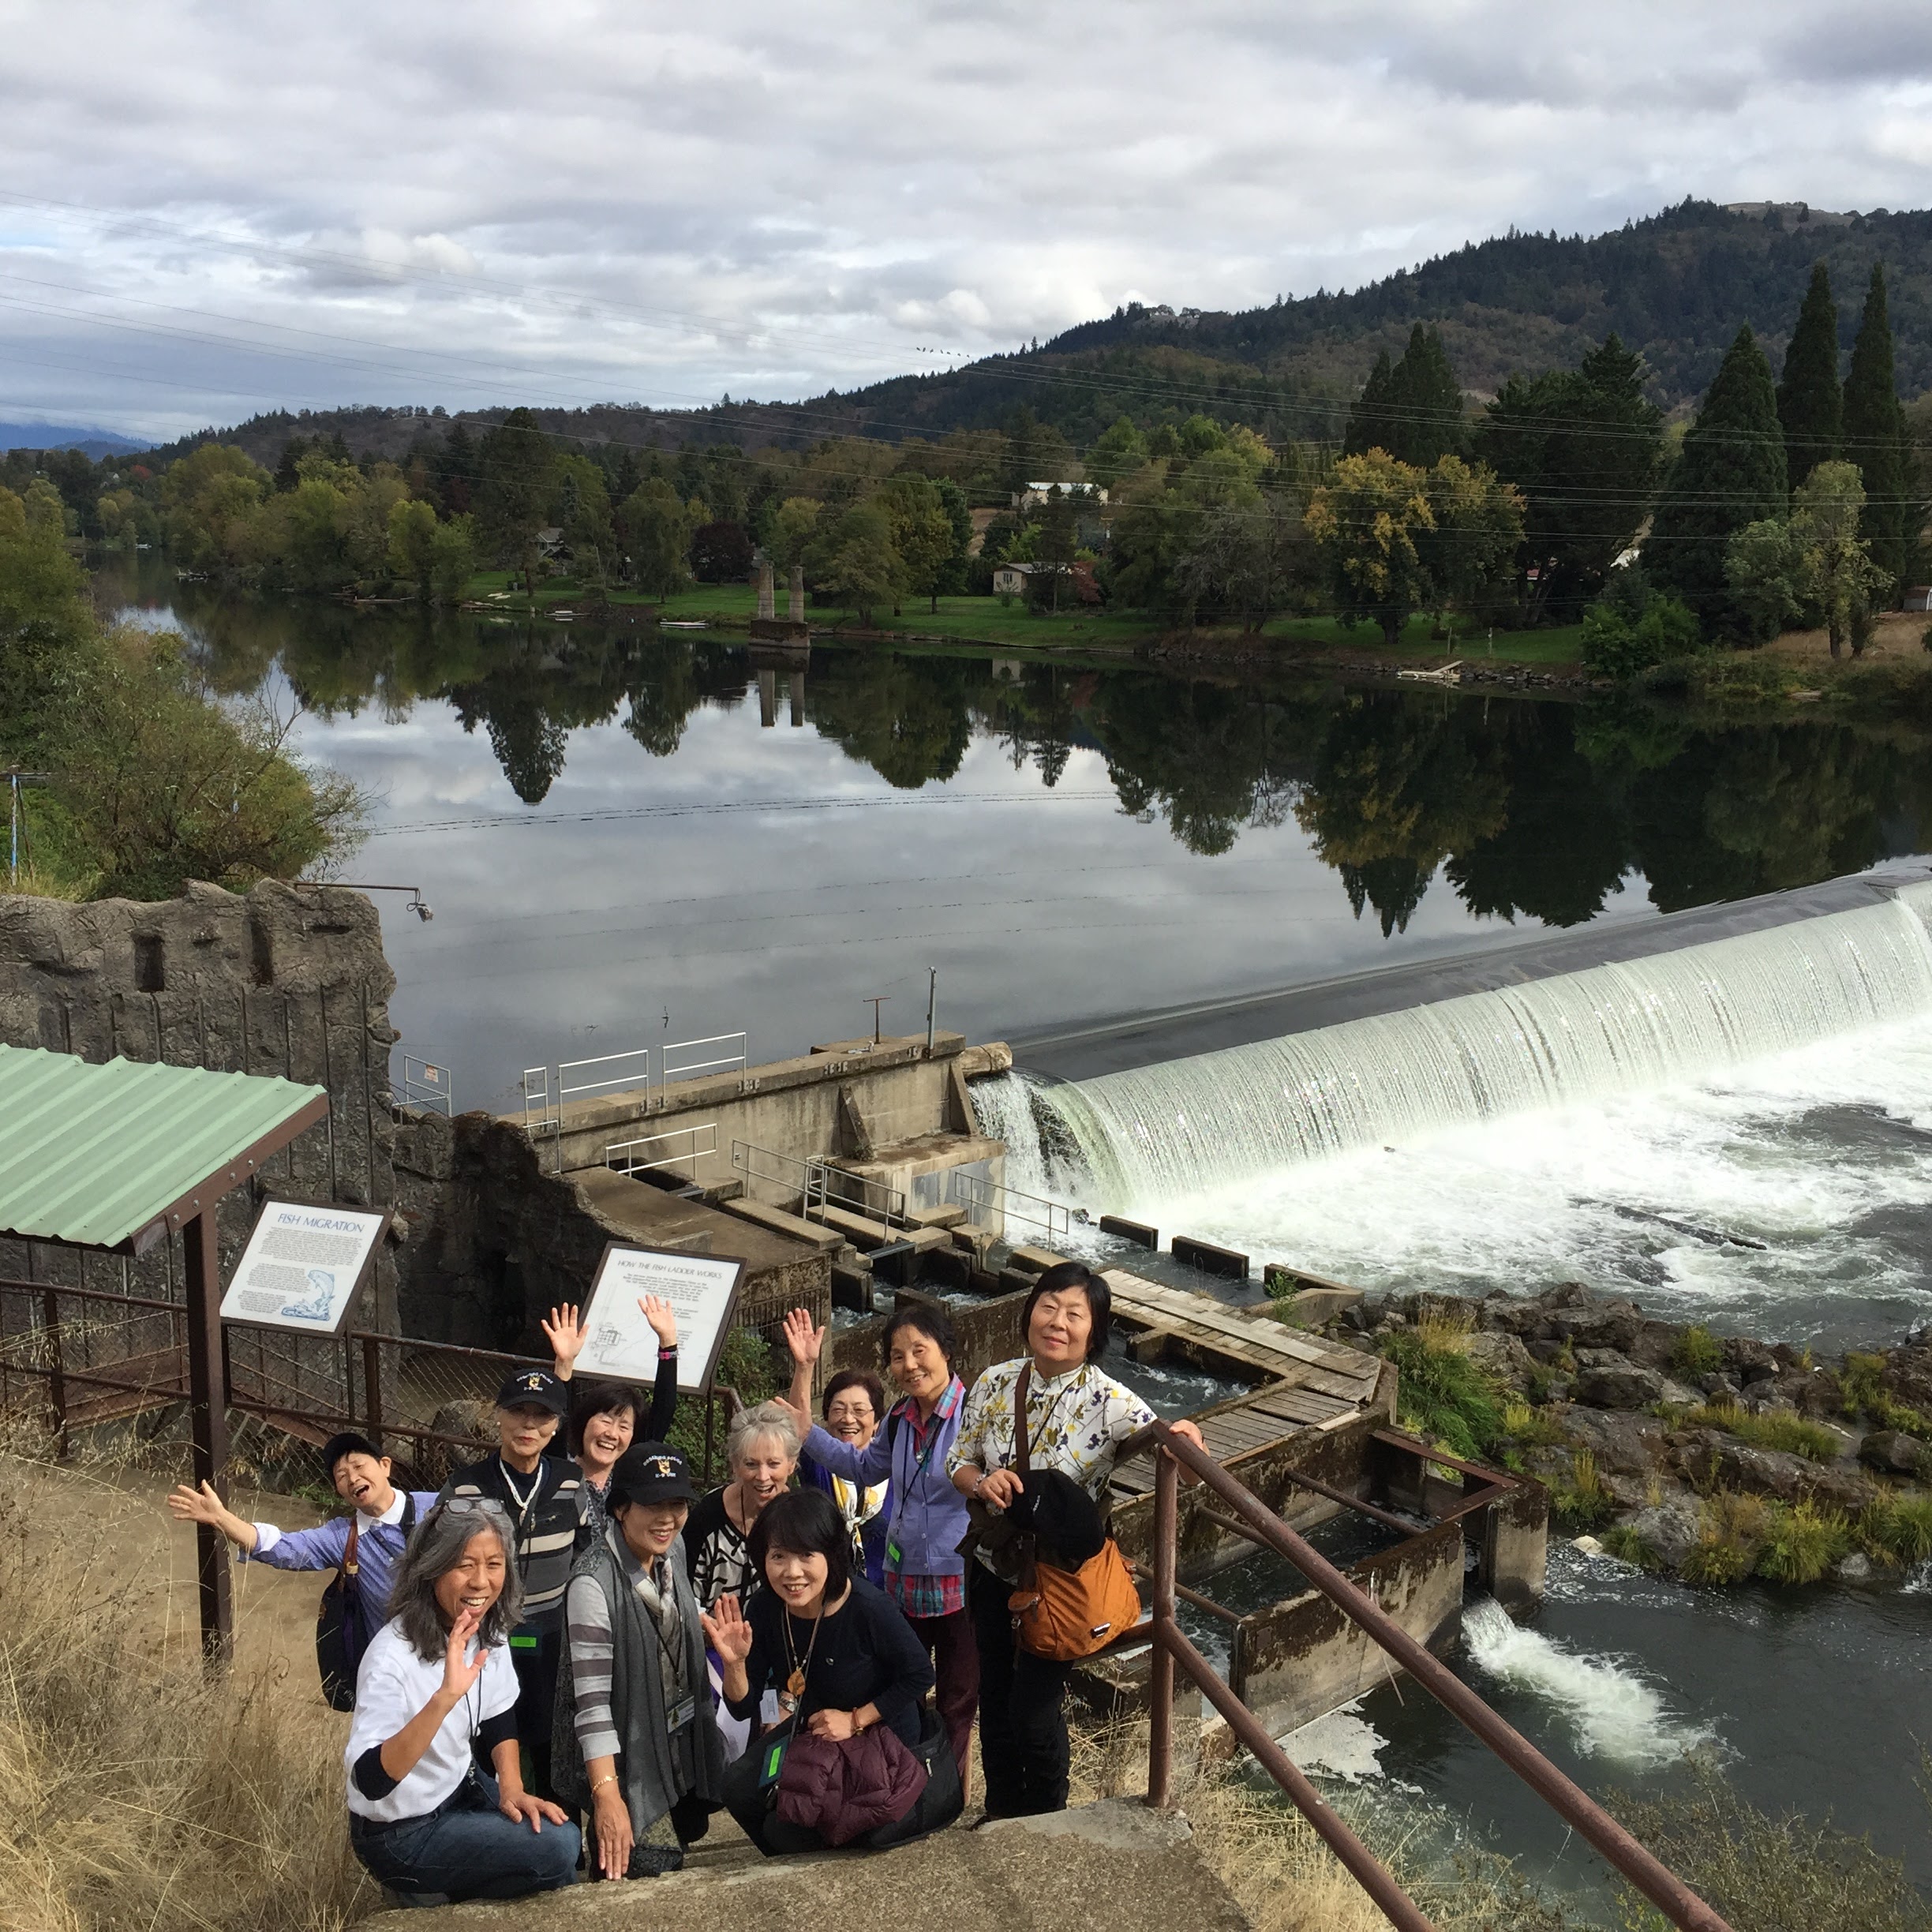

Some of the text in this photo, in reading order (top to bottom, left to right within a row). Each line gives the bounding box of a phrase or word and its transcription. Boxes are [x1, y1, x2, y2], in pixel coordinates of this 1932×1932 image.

[278, 1213, 365, 1233] FISH MIGRATION
[668, 1267, 695, 1275] LADDER
[697, 1270, 722, 1279] WORKS
